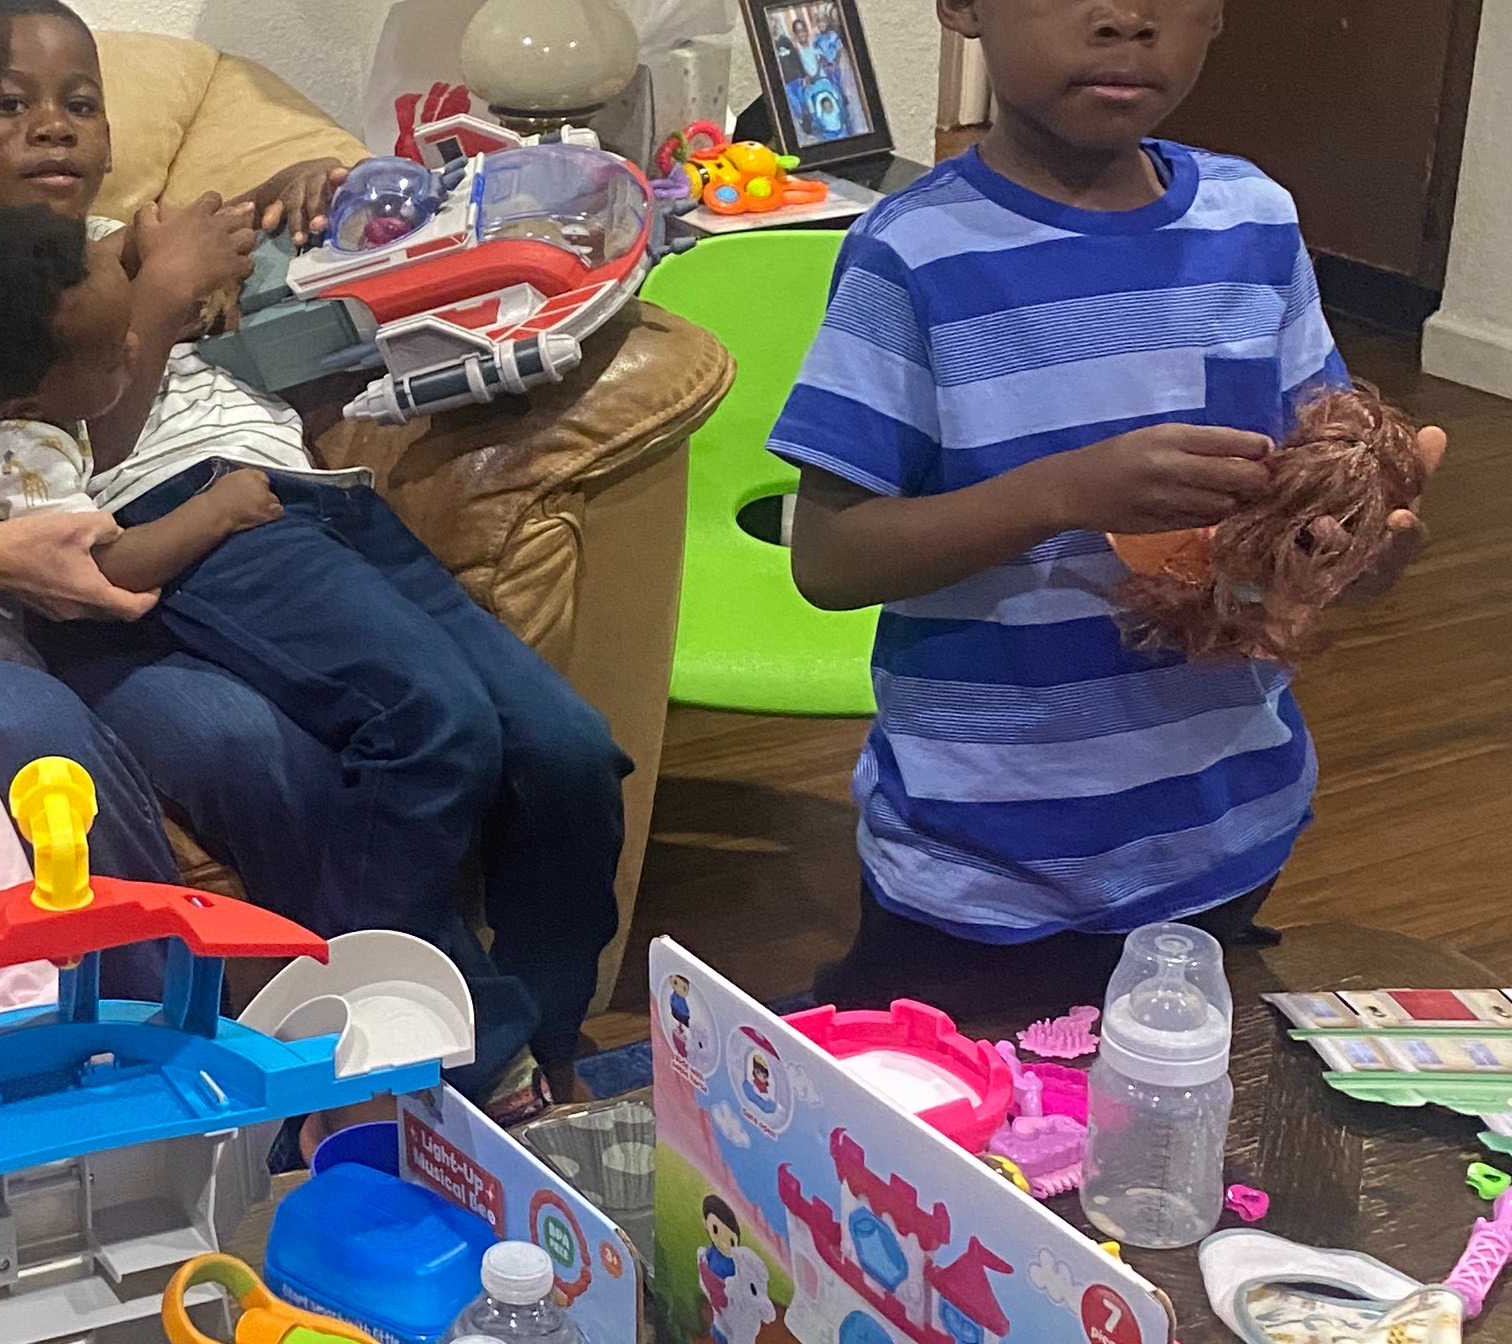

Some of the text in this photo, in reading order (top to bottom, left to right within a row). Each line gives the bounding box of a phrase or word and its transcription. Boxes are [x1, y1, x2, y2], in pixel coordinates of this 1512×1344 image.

[413, 1147, 496, 1225] Musical Bee
[421, 1129, 484, 1196] Light-Up
[1102, 1298, 1122, 1333] 7
